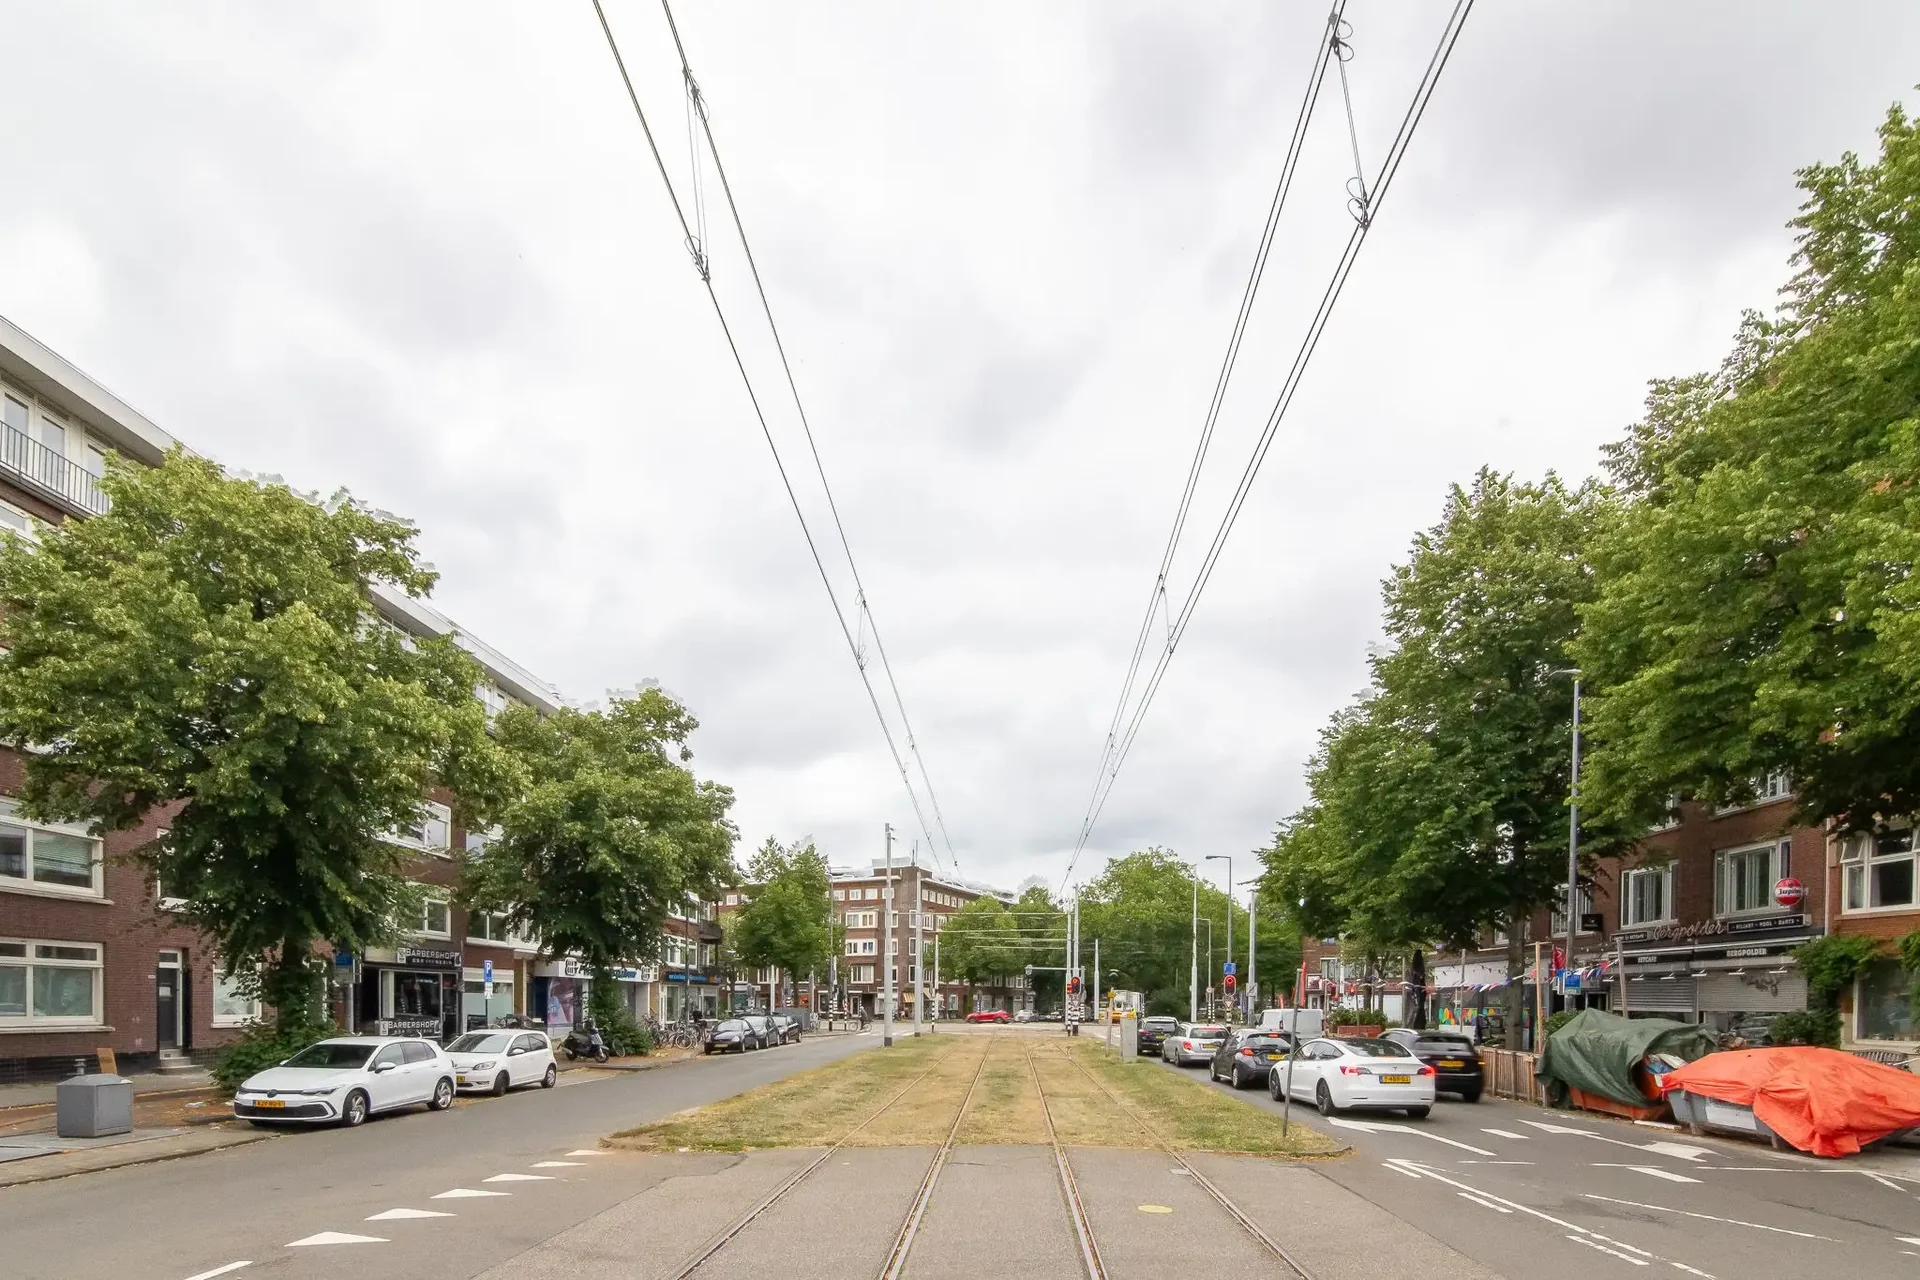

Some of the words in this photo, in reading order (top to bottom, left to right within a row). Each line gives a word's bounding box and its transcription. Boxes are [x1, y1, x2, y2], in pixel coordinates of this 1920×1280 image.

[406, 948, 455, 960] BARBERSHOP
[1726, 947, 1767, 957] BERGPOLDER
[388, 1020, 434, 1029] BARBERSHOP
